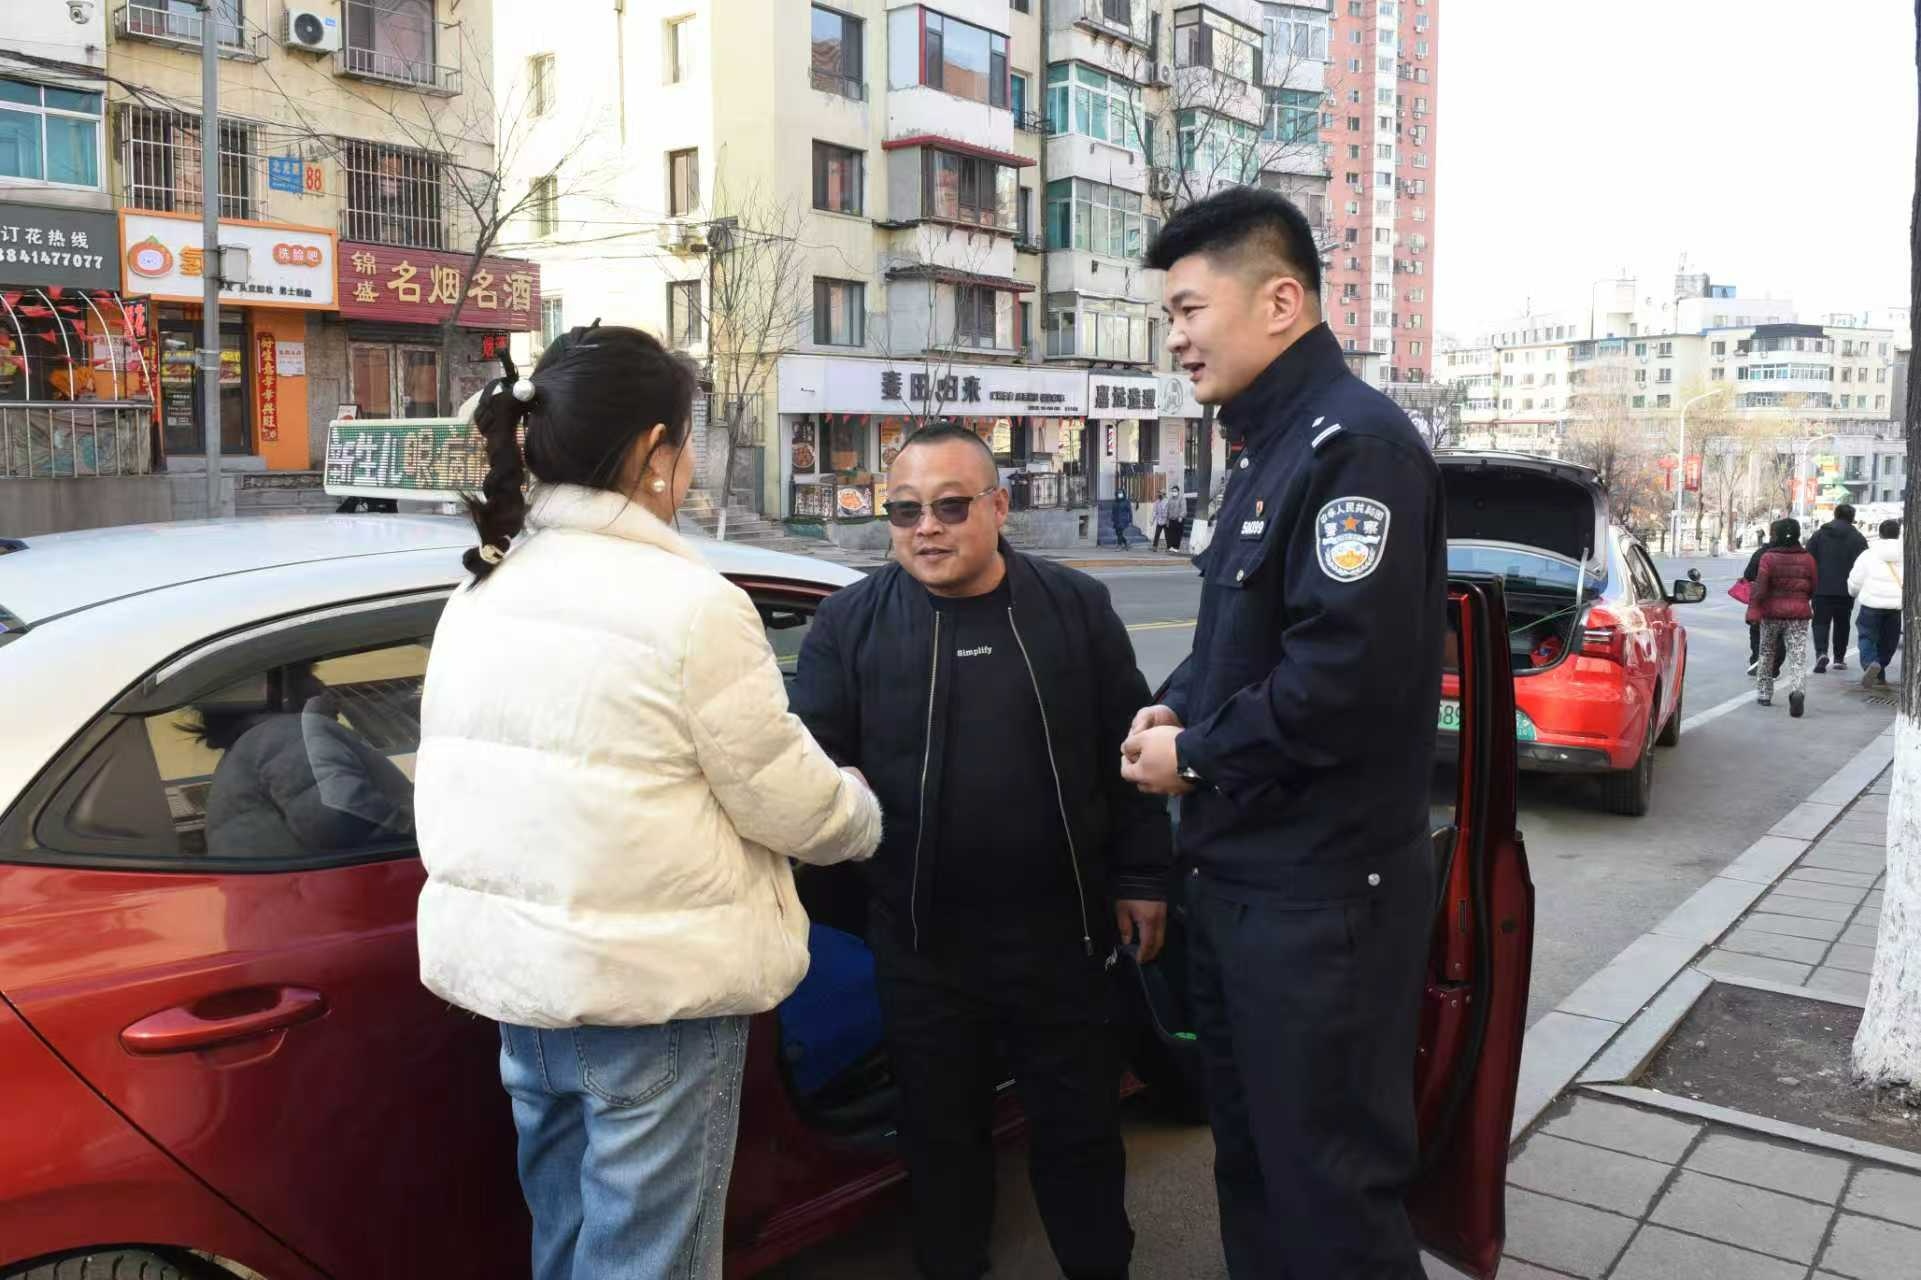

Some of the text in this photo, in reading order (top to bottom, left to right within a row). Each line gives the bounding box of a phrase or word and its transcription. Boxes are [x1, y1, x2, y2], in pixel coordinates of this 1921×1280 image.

[306, 167, 321, 190] 88
[0, 225, 89, 249] 订花热线
[351, 250, 377, 304] 锦盛
[387, 260, 532, 312] 名烟名酒
[1320, 502, 1384, 523] 中华人民共和国
[957, 646, 992, 656] Simplify
